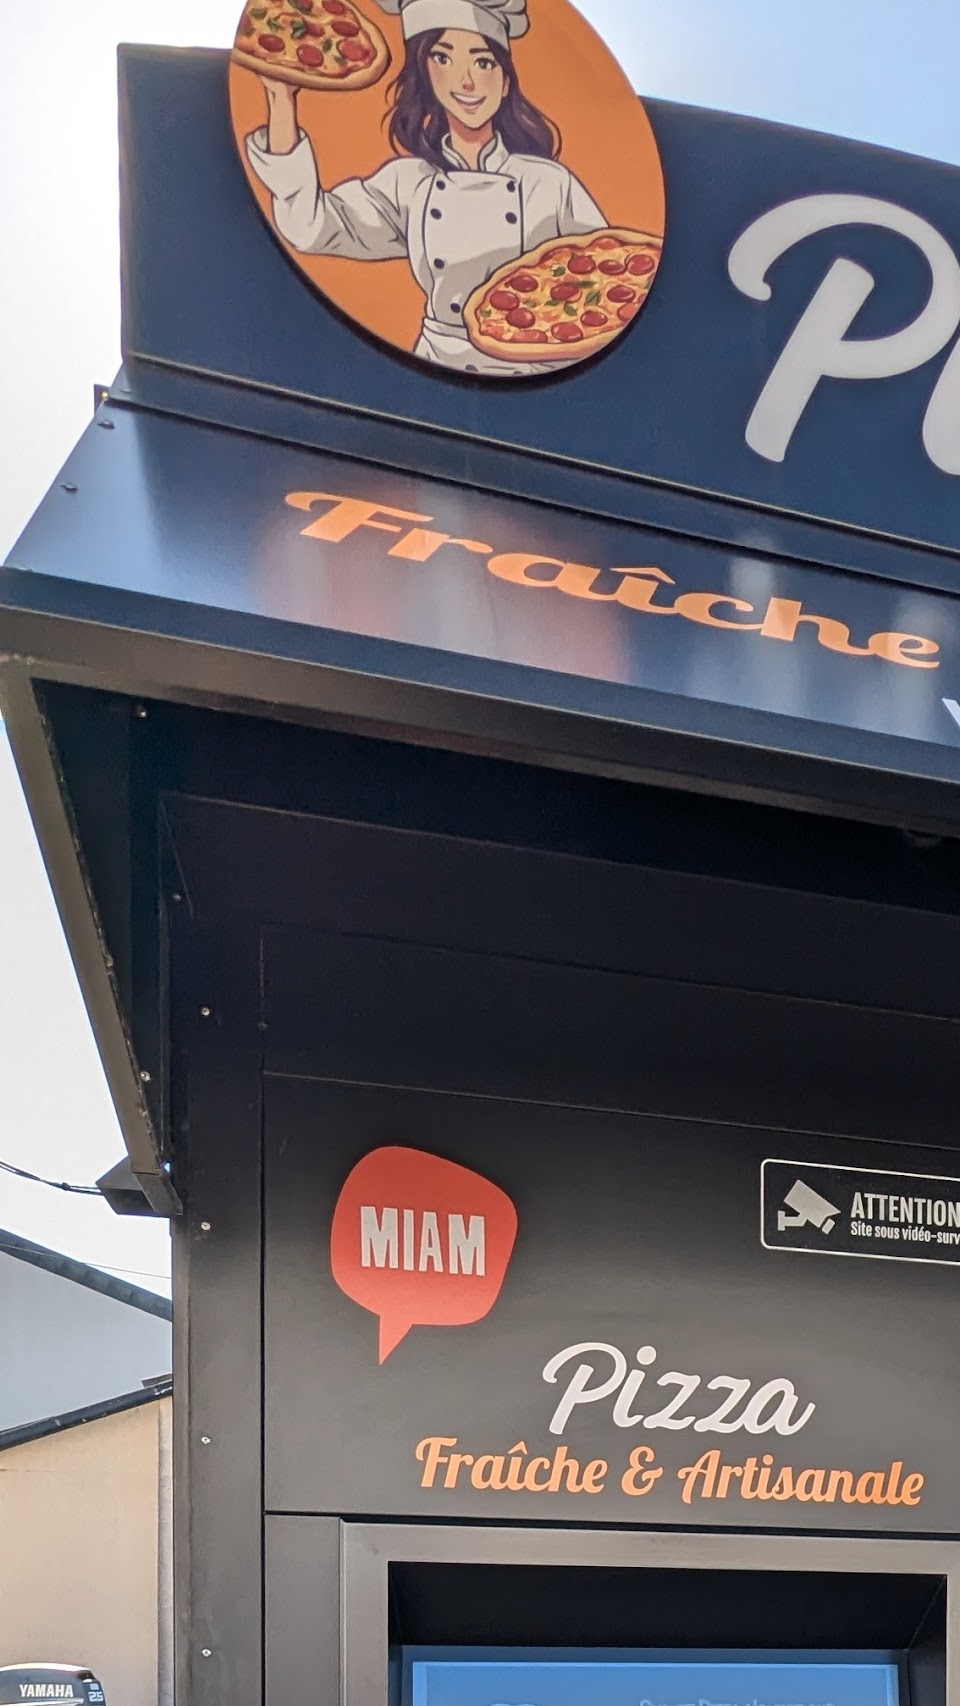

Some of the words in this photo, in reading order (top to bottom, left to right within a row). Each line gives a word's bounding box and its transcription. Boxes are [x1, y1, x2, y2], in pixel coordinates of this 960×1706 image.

[285, 491, 939, 669] Fraîche
[360, 1205, 486, 1277] MIAM
[850, 1221, 873, 1237] Site
[875, 1225, 900, 1240] sous
[542, 1341, 816, 1436] Pizza
[414, 1436, 609, 1494] Fraîche
[621, 1446, 664, 1497] &
[677, 1449, 925, 1506] Artisanale
[19, 1684, 74, 1698] YAMAHA
[88, 1691, 104, 1702] 25
